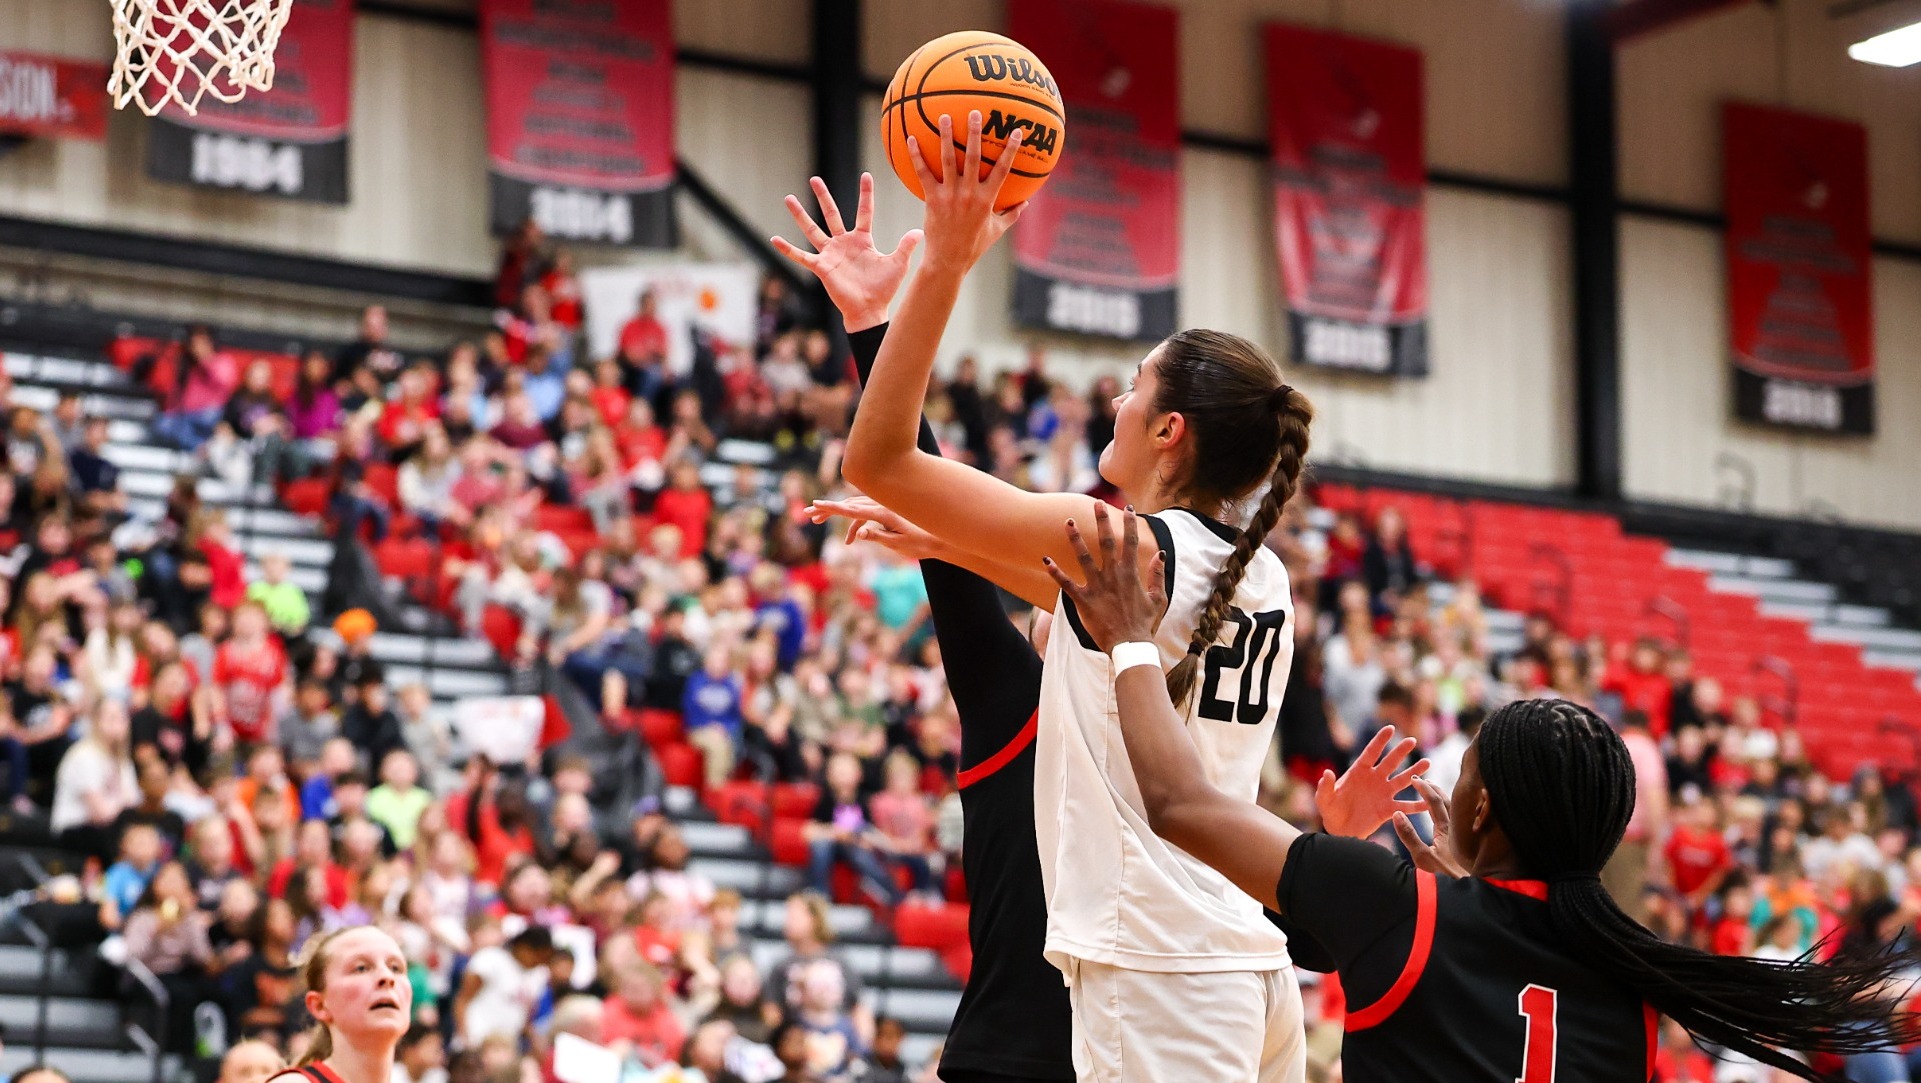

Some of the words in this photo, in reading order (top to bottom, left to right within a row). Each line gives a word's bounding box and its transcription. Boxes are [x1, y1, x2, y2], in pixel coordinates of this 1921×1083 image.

[982, 110, 1057, 155] NCAA
[1198, 605, 1285, 724] 20
[1514, 983, 1557, 1083] 1
